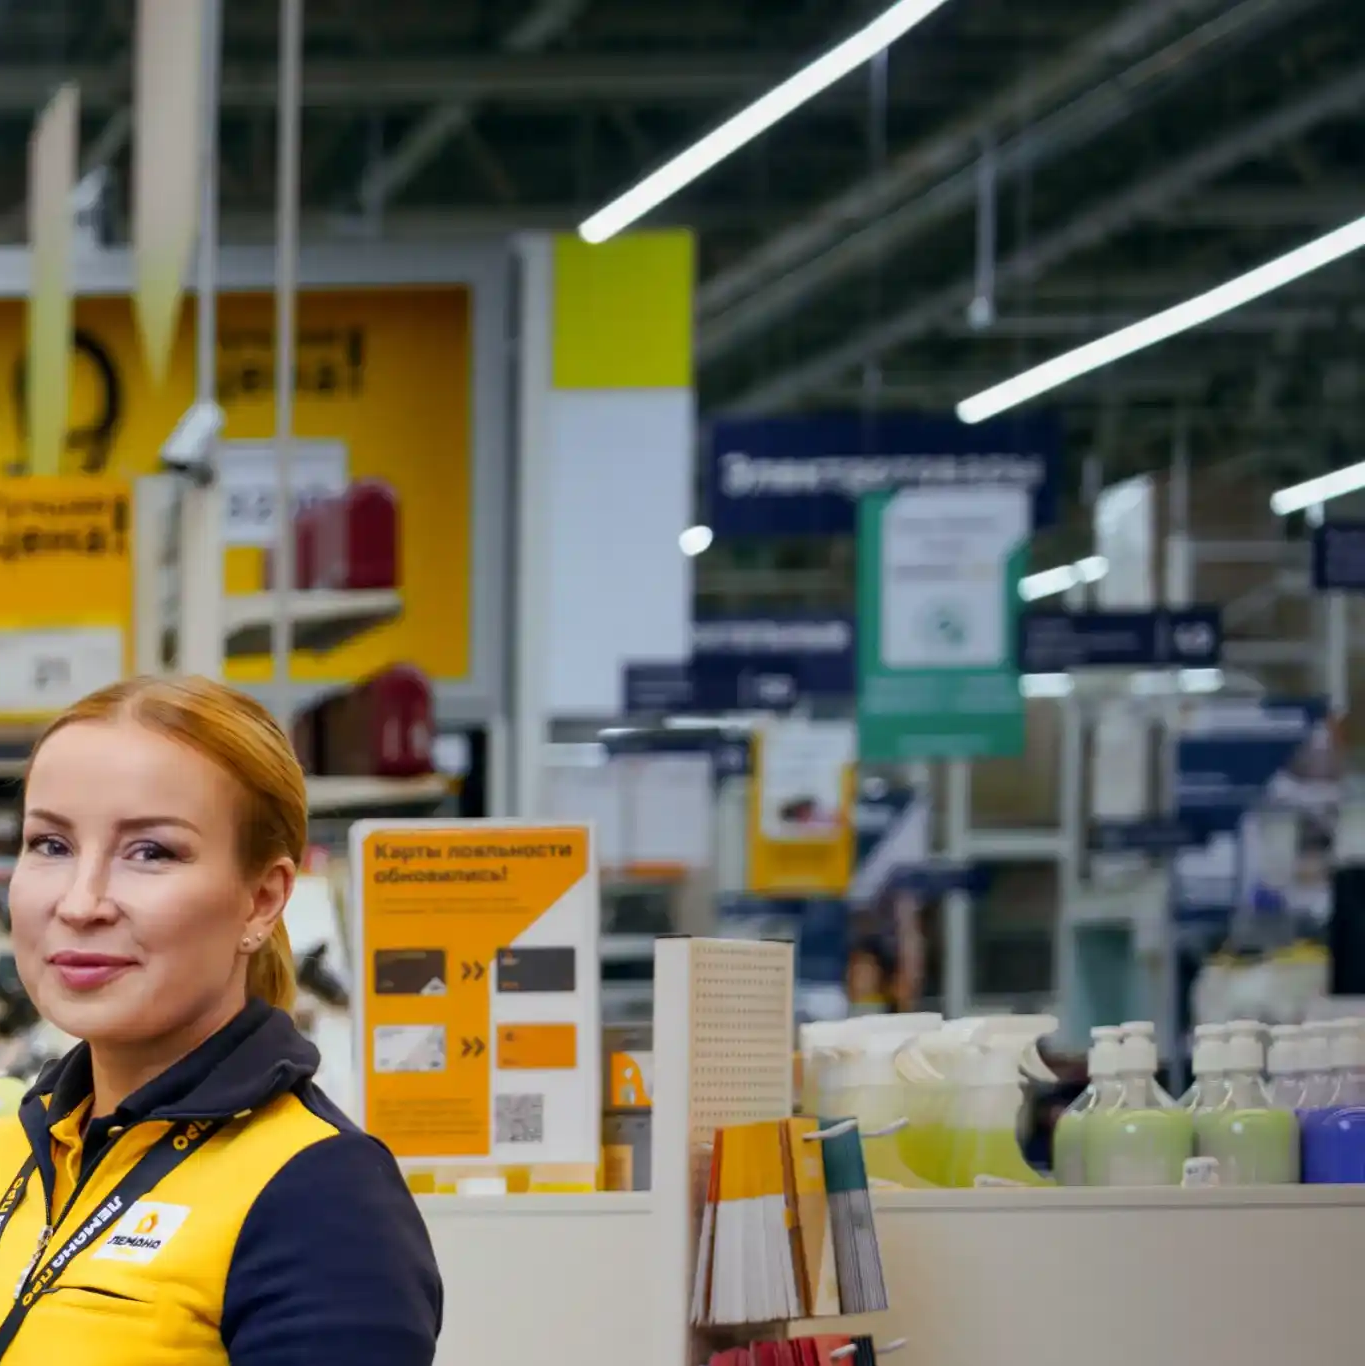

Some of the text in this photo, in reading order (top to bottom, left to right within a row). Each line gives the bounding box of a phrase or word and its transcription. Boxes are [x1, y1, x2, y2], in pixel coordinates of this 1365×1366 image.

[374, 844, 573, 863] Карты лояльности
[374, 865, 508, 884] обновились!
